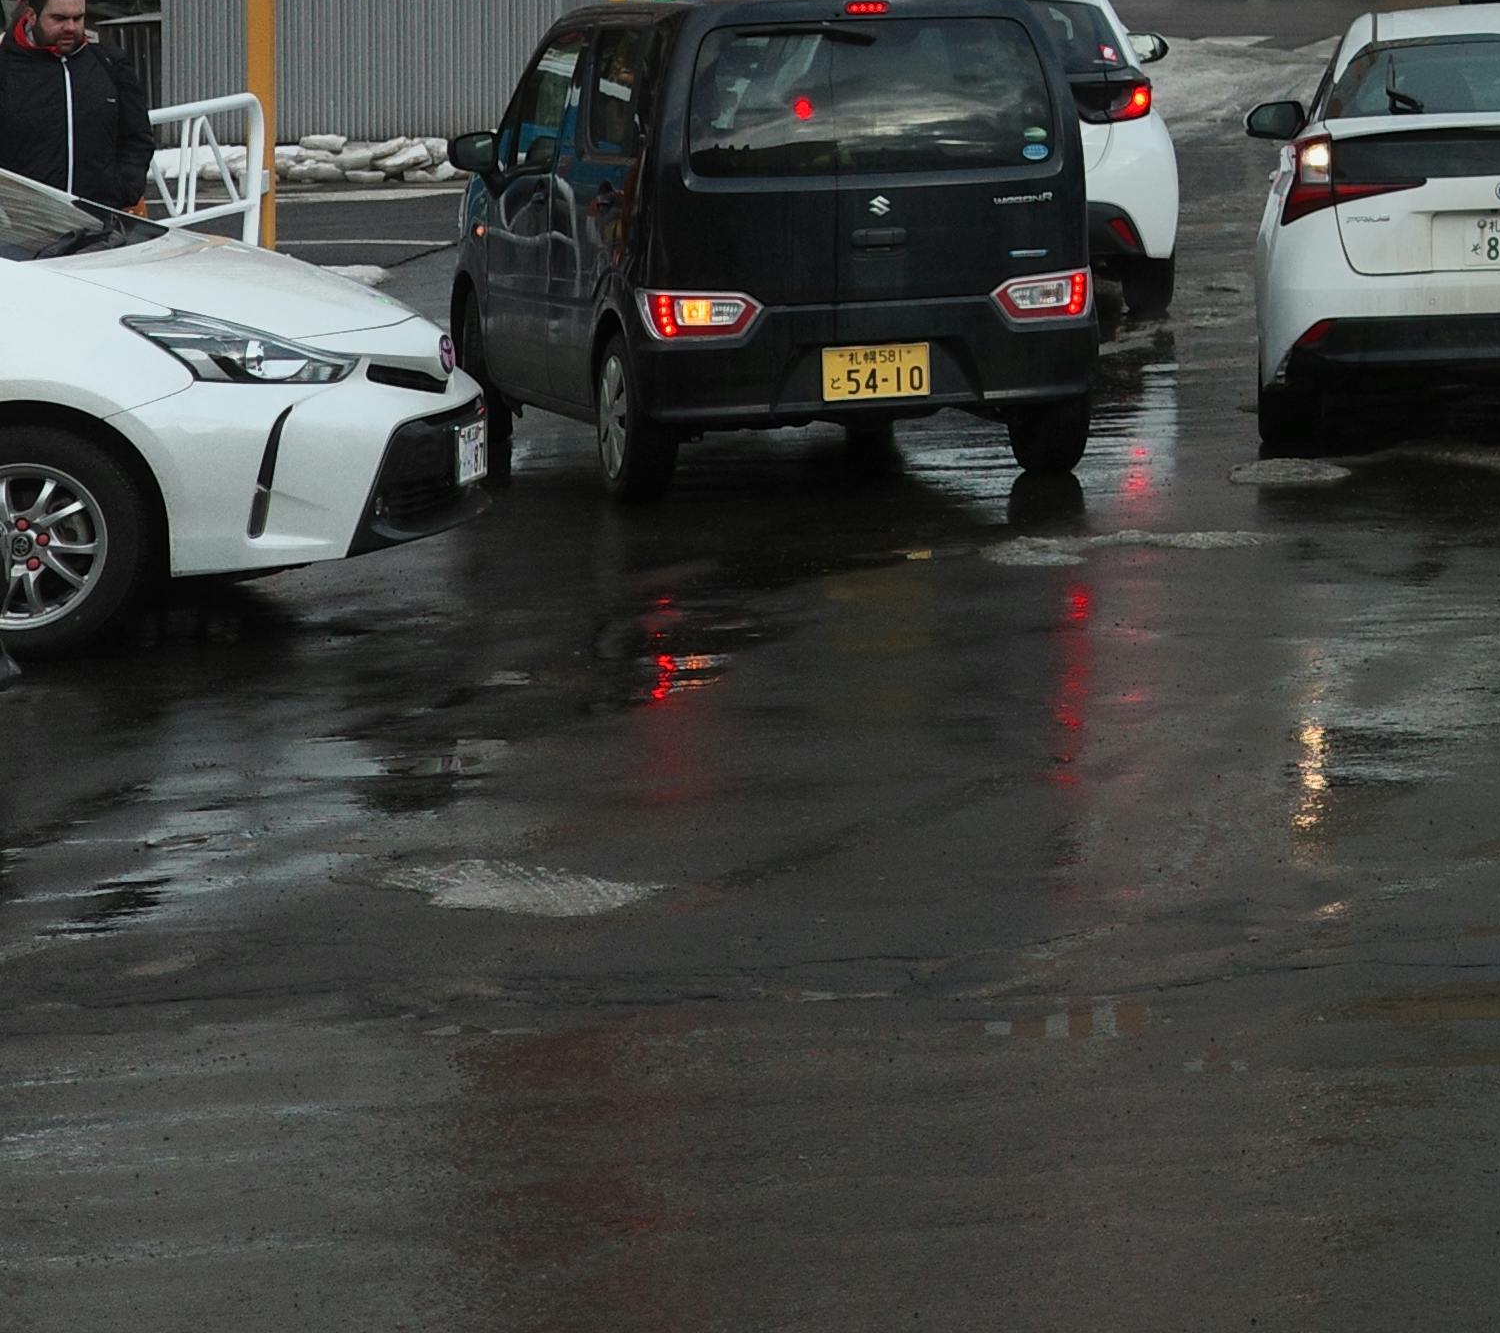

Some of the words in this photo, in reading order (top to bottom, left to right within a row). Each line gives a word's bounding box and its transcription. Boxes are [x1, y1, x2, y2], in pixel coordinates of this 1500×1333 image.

[847, 350, 904, 365] 札幌581
[831, 376, 842, 391] と
[846, 365, 924, 395] 54-10
